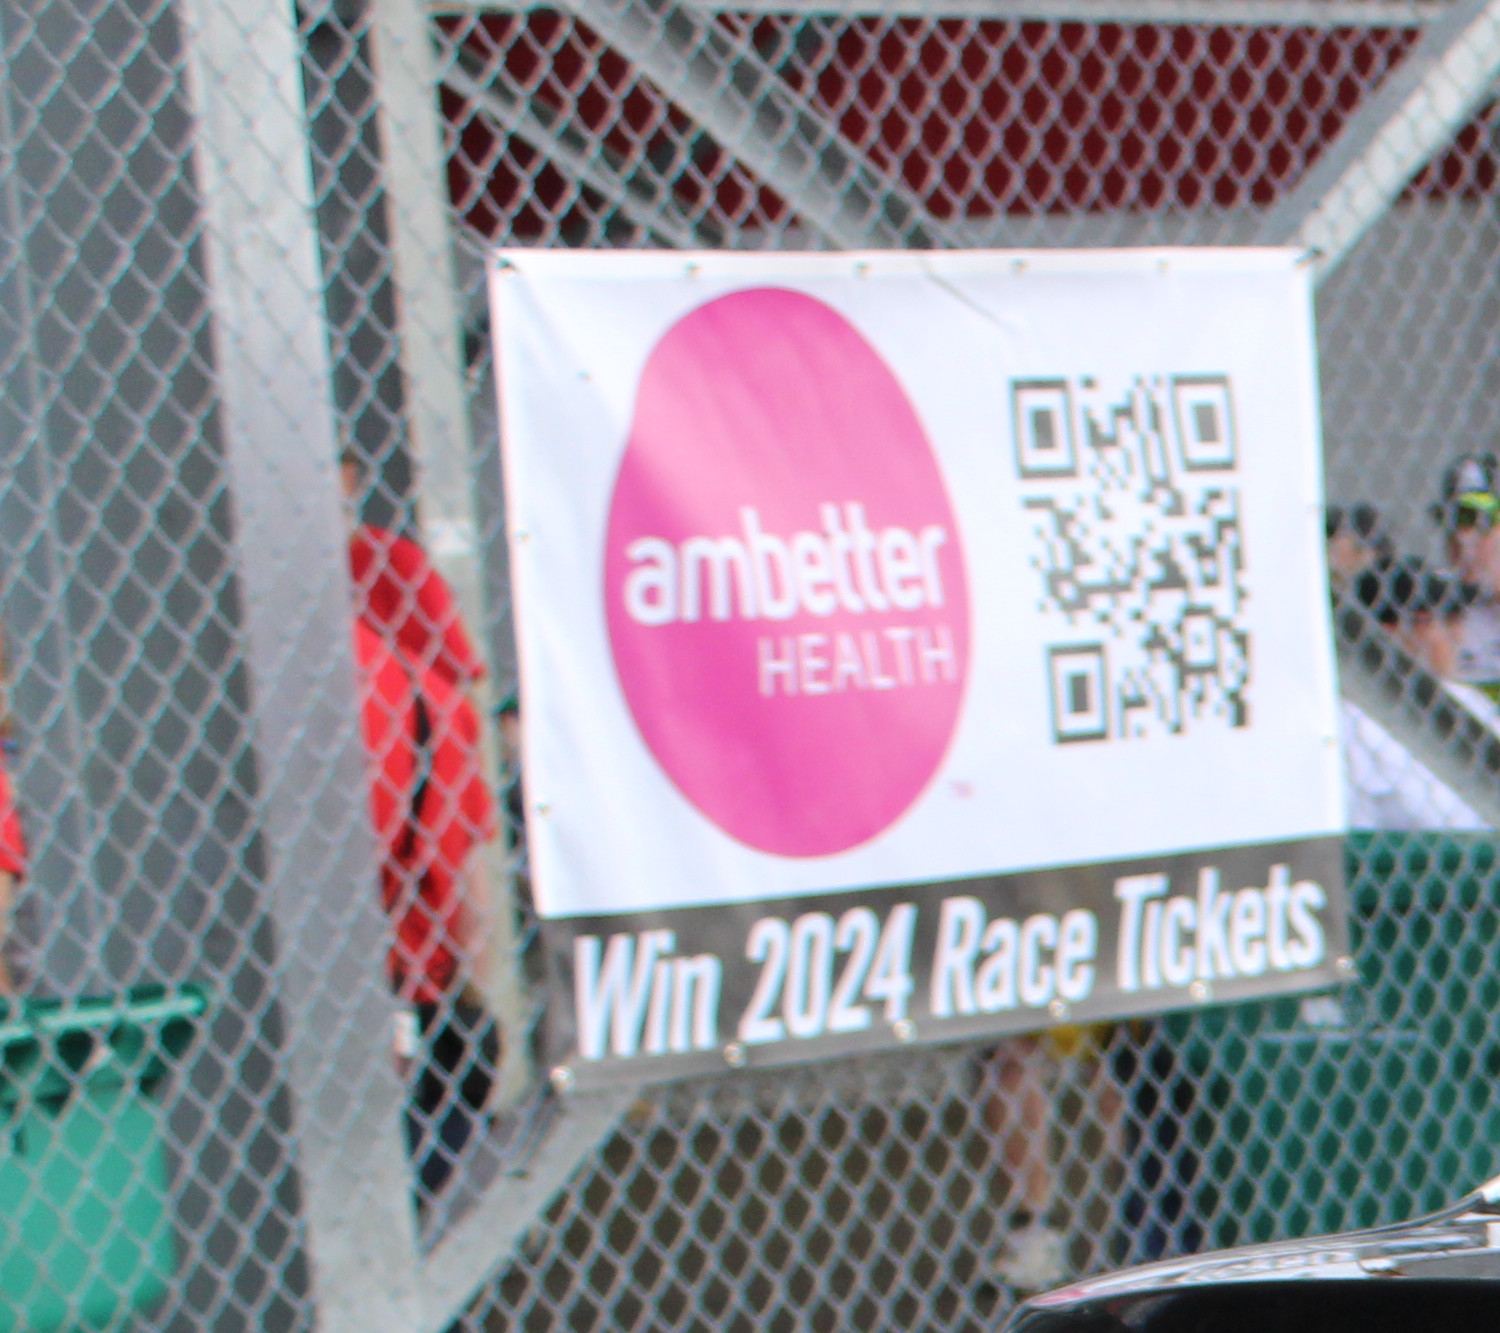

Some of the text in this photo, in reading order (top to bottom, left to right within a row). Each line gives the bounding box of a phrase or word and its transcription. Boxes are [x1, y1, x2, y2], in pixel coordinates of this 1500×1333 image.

[623, 501, 947, 627] ambetter
[757, 625, 957, 697] HEALTH
[572, 862, 1328, 1062] Win 2024 Race Tickets
